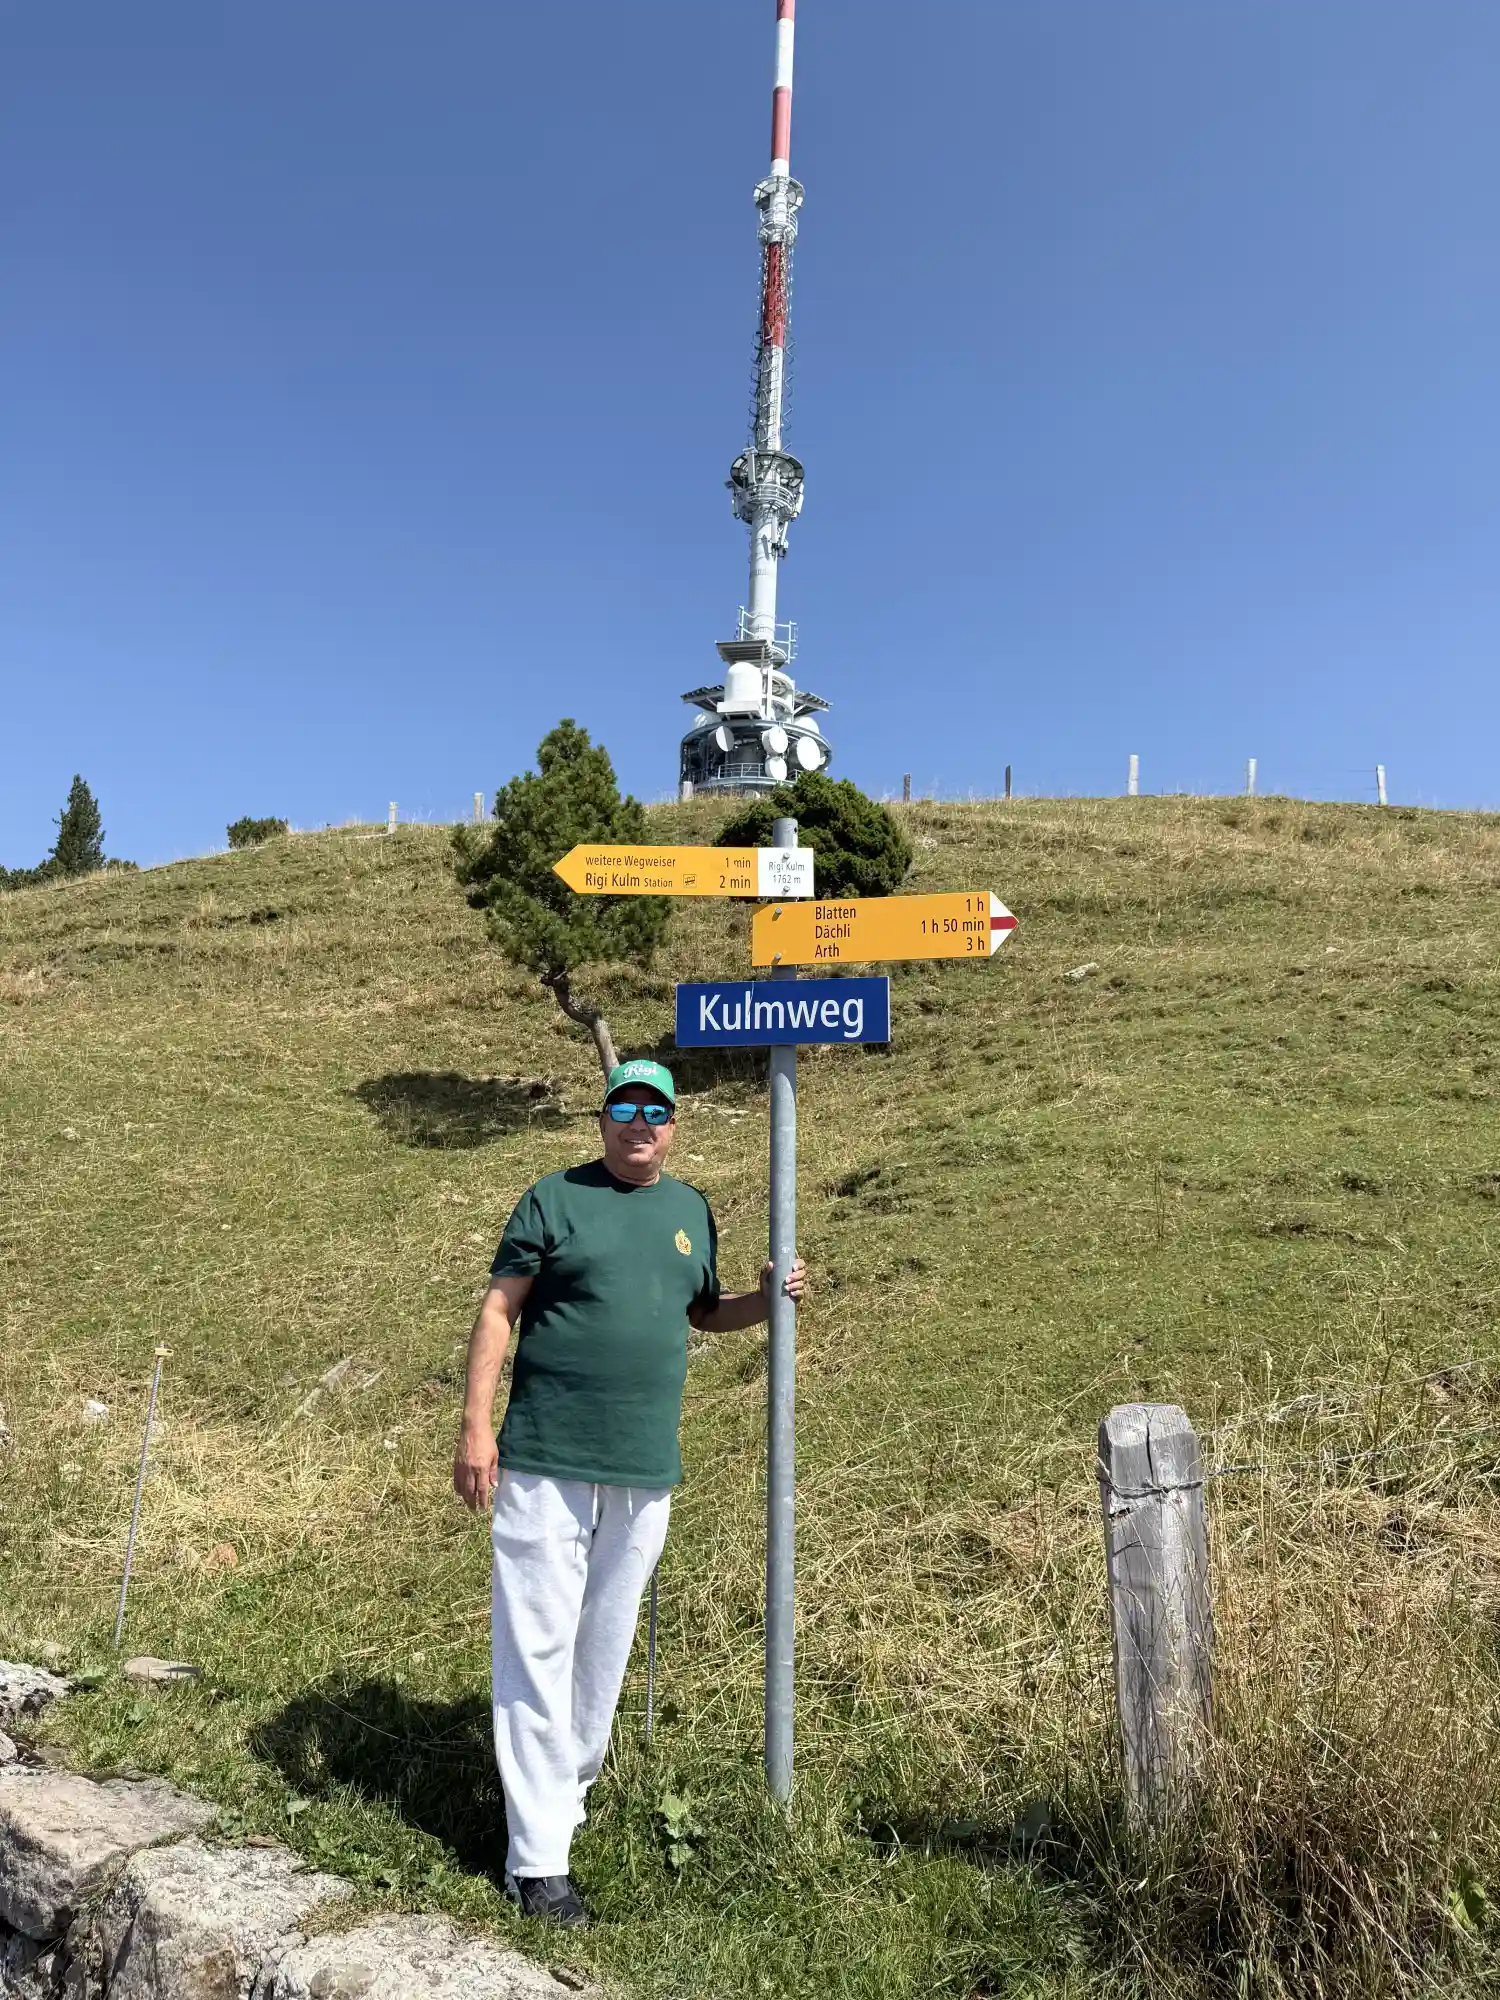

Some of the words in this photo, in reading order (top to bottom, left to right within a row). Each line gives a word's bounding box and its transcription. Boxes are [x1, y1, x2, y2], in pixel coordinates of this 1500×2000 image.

[585, 856, 622, 866] weitere
[623, 856, 676, 869] Wegweiser
[725, 857, 730, 868] 1
[733, 857, 751, 868] min
[768, 861, 784, 873] Rigi
[786, 861, 805, 871] Kulm
[585, 873, 608, 890] Rigi
[611, 873, 640, 887] Kulm
[644, 877, 673, 888] Station
[719, 875, 726, 888] 2
[730, 874, 751, 889] min
[773, 874, 792, 883] 1762
[966, 899, 972, 912] 1
[976, 898, 984, 912] h
[815, 906, 857, 920] Blatten
[815, 924, 851, 939] Dächli
[921, 920, 927, 934] 1
[932, 919, 939, 933] h
[943, 919, 957, 933] 50
[962, 917, 985, 932] min
[814, 943, 840, 958] Arth
[966, 938, 973, 951] 3
[977, 937, 985, 950] h
[699, 990, 864, 1038] Kulmweg
